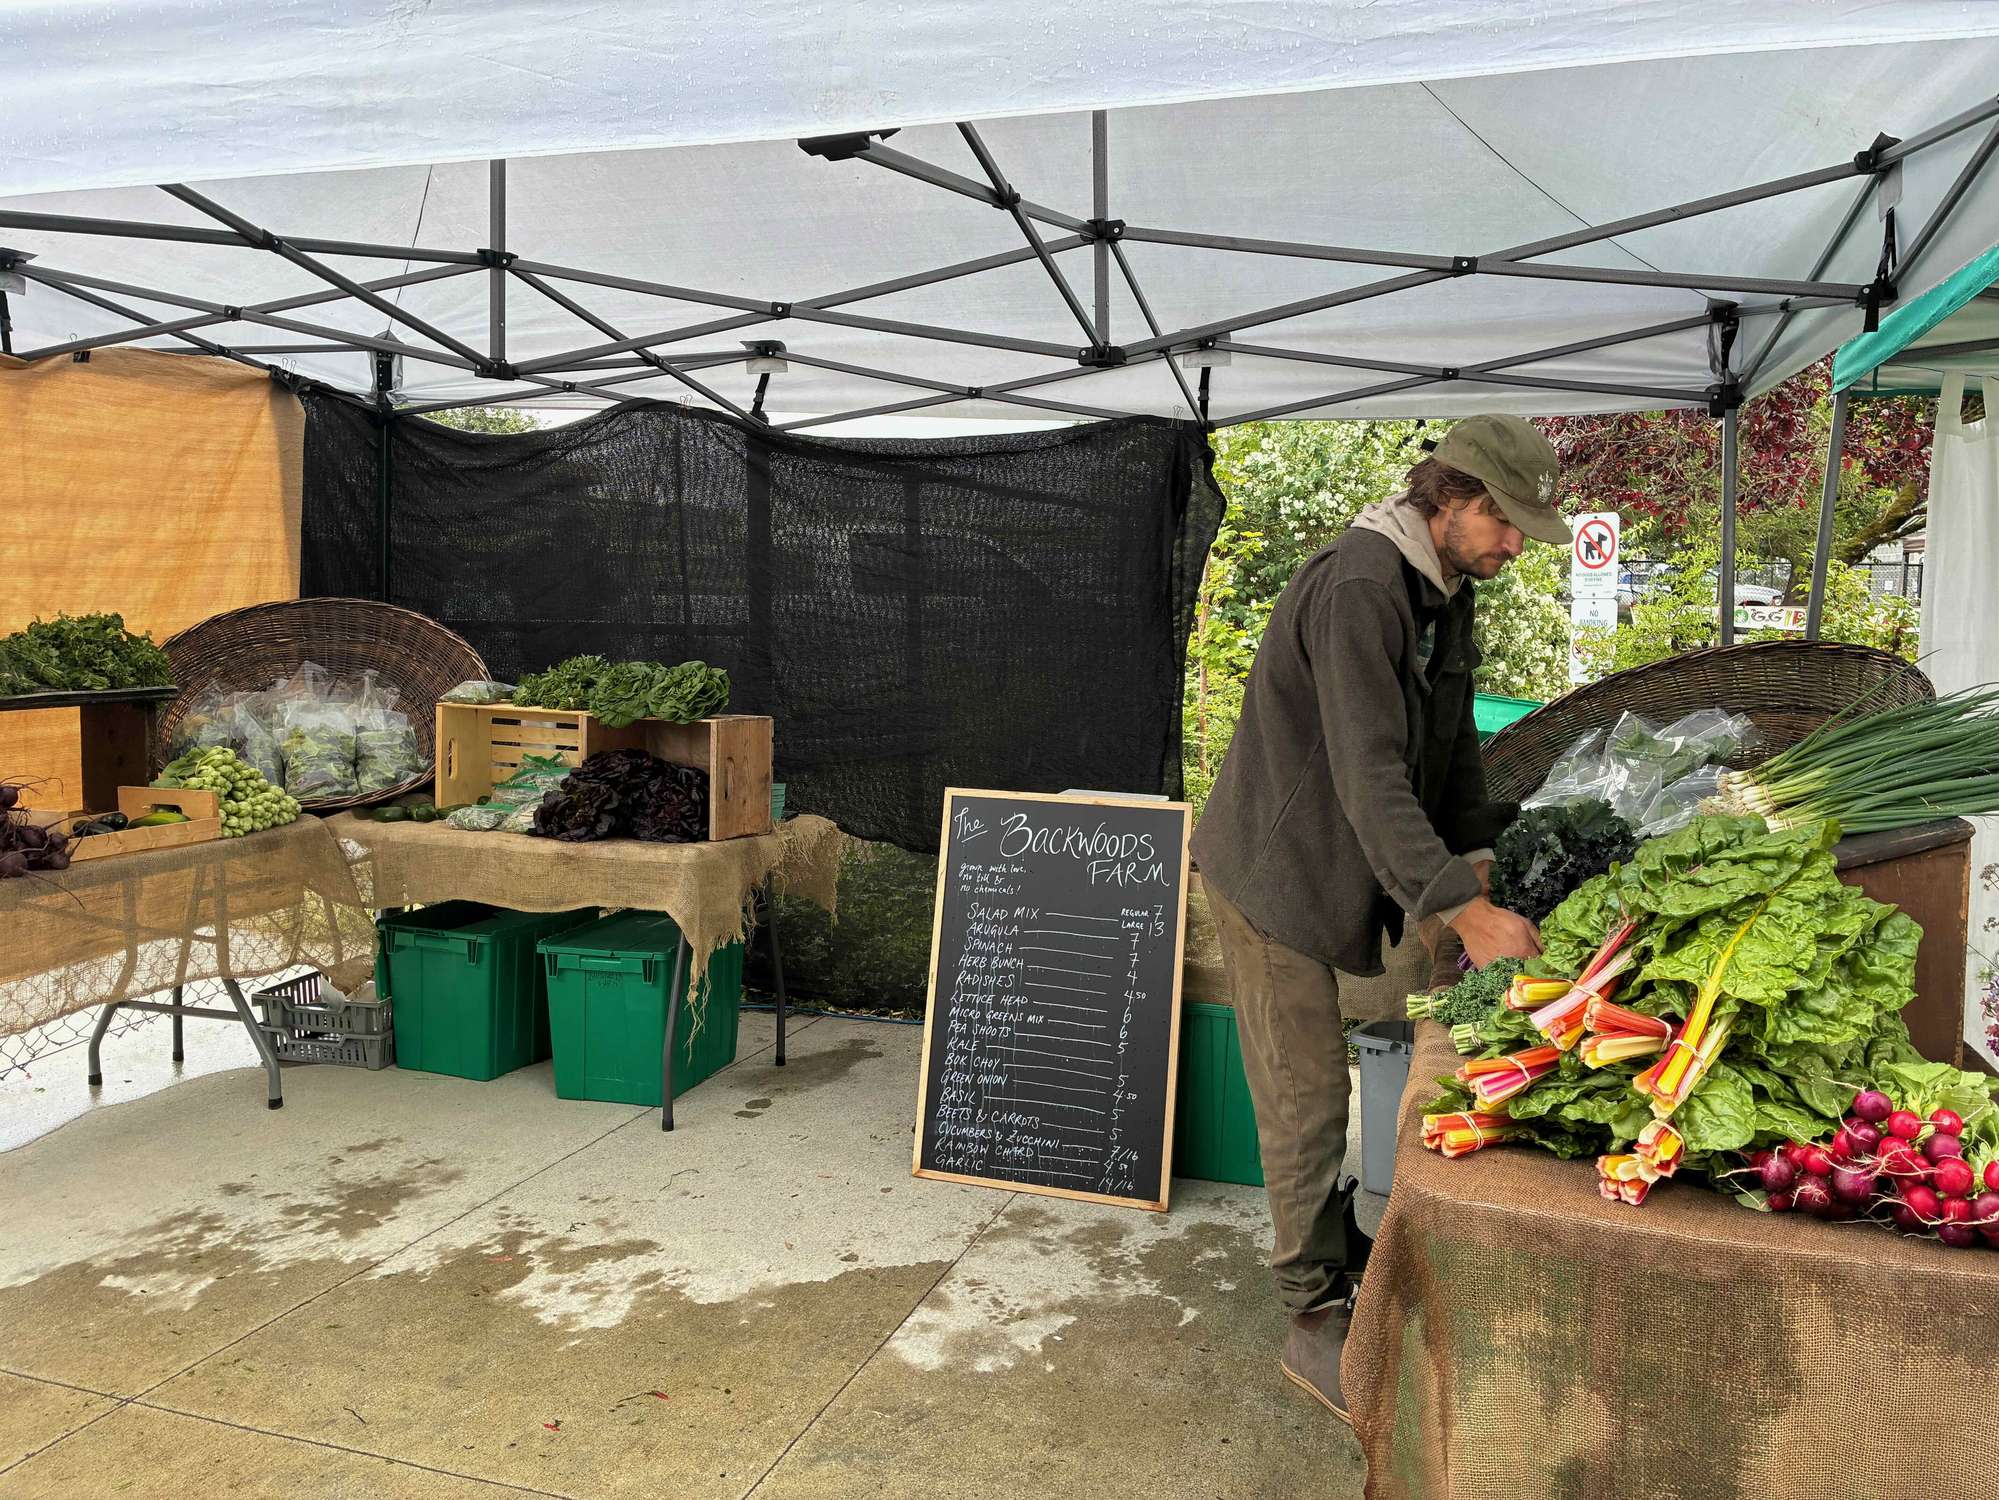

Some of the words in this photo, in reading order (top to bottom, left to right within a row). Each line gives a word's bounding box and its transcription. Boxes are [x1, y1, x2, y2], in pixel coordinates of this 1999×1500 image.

[954, 807, 985, 840] The
[976, 873, 990, 884] till
[994, 875, 1005, 885] &
[989, 863, 1007, 873] with
[1086, 859, 1170, 887] FARM
[967, 902, 1008, 920] SALAD
[1013, 906, 1040, 919] MIX
[1121, 908, 1149, 917] REGULAR
[1153, 904, 1163, 922] 7
[966, 921, 1019, 937] ARUGULA
[1129, 933, 1139, 950] 7
[1121, 920, 1144, 930] LARGE
[1148, 921, 1165, 937] 13
[964, 936, 1012, 954] SPINACH
[1129, 952, 1140, 968] 7
[955, 970, 1015, 988] RADISHES
[958, 954, 987, 969] HERB
[990, 956, 1024, 969] BUNCH
[1127, 970, 1138, 986] 4
[950, 989, 996, 1005] LETTUCE
[1000, 994, 1028, 1007] HEAD
[1123, 1006, 1132, 1023] 6
[949, 1006, 980, 1020] MICRO
[986, 1009, 1024, 1024] GREENS
[1027, 1014, 1044, 1024] MIX
[1120, 1024, 1128, 1038] 6
[947, 1036, 980, 1050] KALE
[948, 1020, 967, 1034] PEA
[973, 1023, 1011, 1037] SHOOTS
[1117, 1042, 1129, 1054] 5
[940, 1068, 975, 1086] GREEN
[976, 1073, 1008, 1085] ONION
[945, 1052, 968, 1065] BOK
[973, 1056, 1000, 1070] CHOY
[1117, 1074, 1129, 1087] 5
[940, 1086, 975, 1104] BASIL
[1110, 1108, 1125, 1120] 5
[936, 1104, 972, 1120] BEETS
[975, 1109, 988, 1122] &
[991, 1110, 1040, 1130] CARROTS
[1109, 1127, 1122, 1140] 5
[938, 1121, 992, 1139] CUCUMBERS
[1006, 1130, 1060, 1149] ZUCCHINI
[935, 1137, 989, 1154] RAINBOW
[995, 1145, 1034, 1157] CHARD
[935, 1153, 983, 1170] GARLIC
